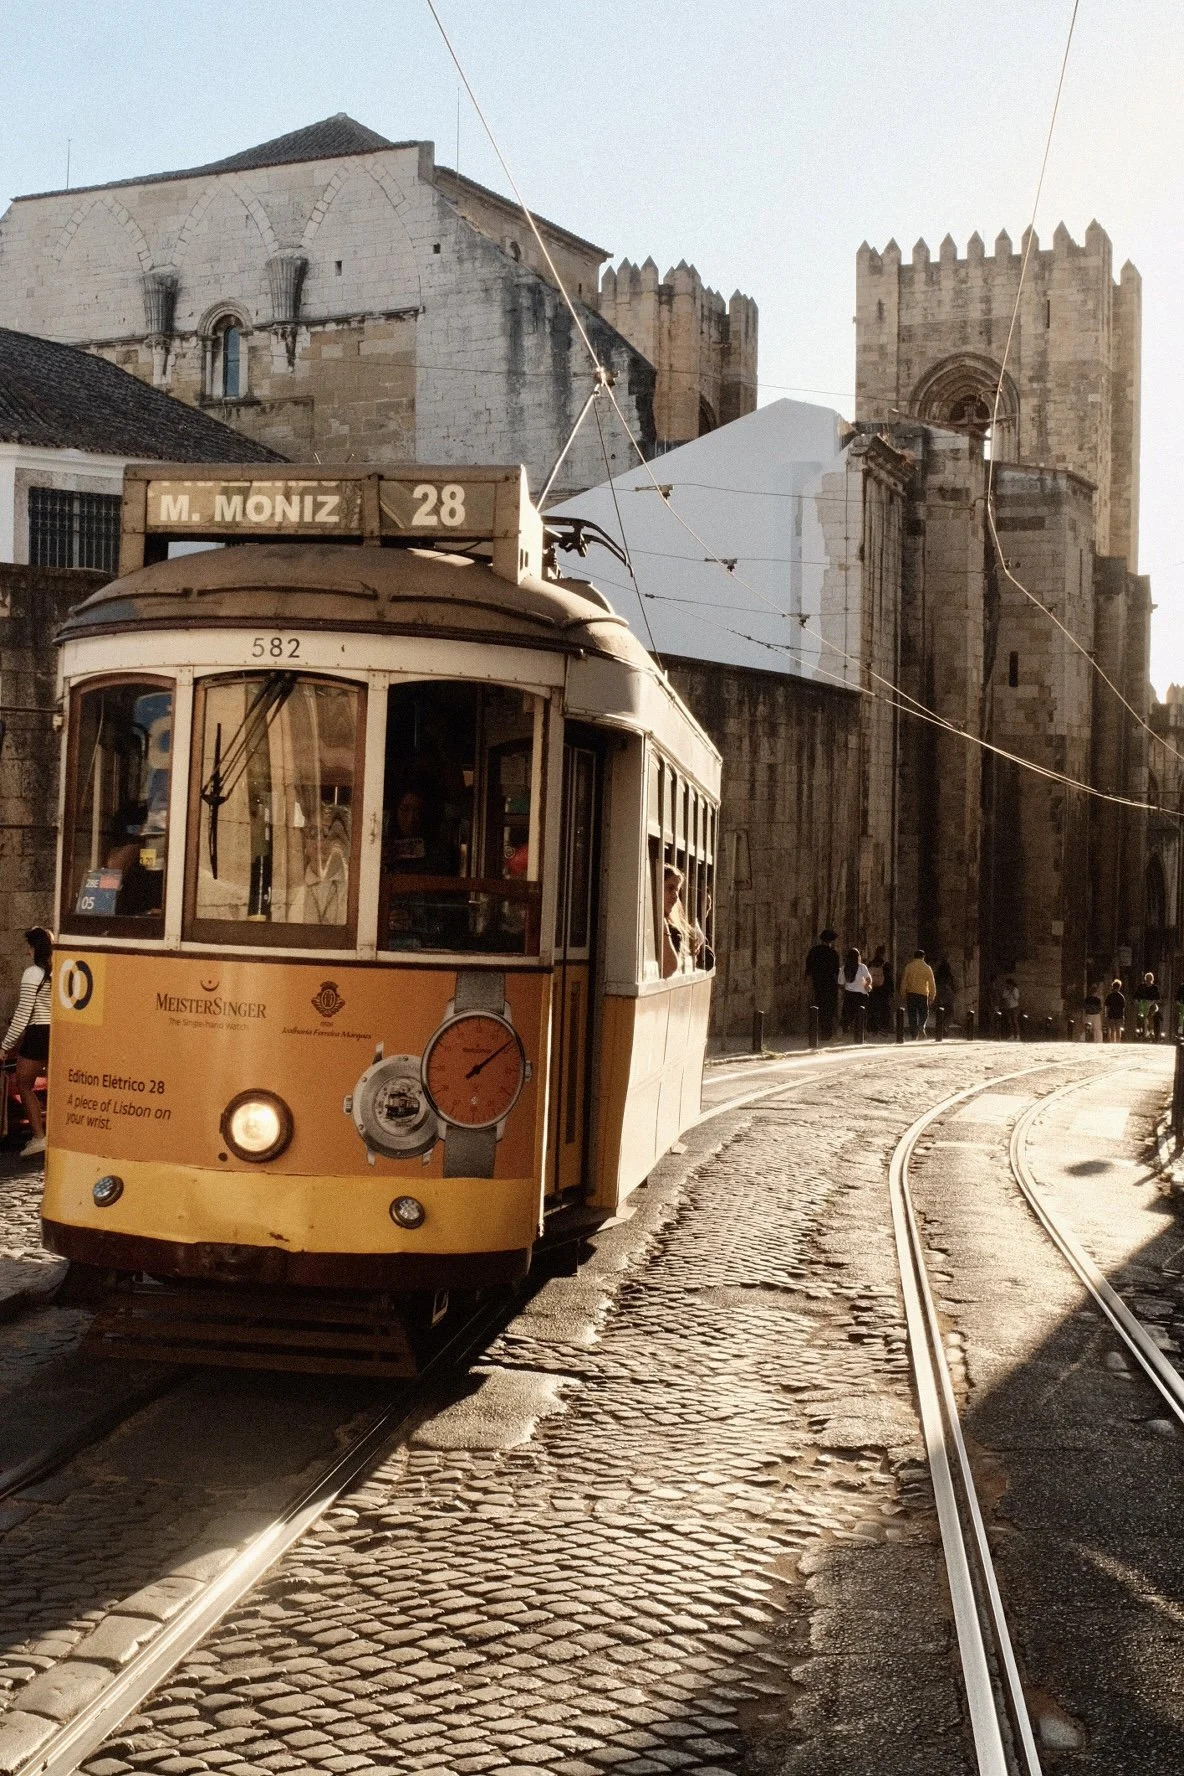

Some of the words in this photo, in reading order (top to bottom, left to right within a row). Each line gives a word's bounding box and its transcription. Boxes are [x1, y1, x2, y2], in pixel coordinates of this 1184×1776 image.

[160, 494, 201, 522] M.
[214, 495, 340, 523] MONIZ
[411, 484, 466, 526] 28
[252, 637, 300, 658] 582
[81, 896, 96, 910] 05
[68, 1068, 99, 1086] Edition
[102, 1073, 146, 1092] Elétrico
[149, 1080, 165, 1095] 28
[67, 1093, 73, 1105] A
[74, 1095, 98, 1110] piece
[100, 1098, 113, 1113] of
[113, 1101, 151, 1118] Lisbon
[154, 1108, 172, 1120] on
[65, 1111, 85, 1125] your
[86, 1115, 112, 1131] wrist.
